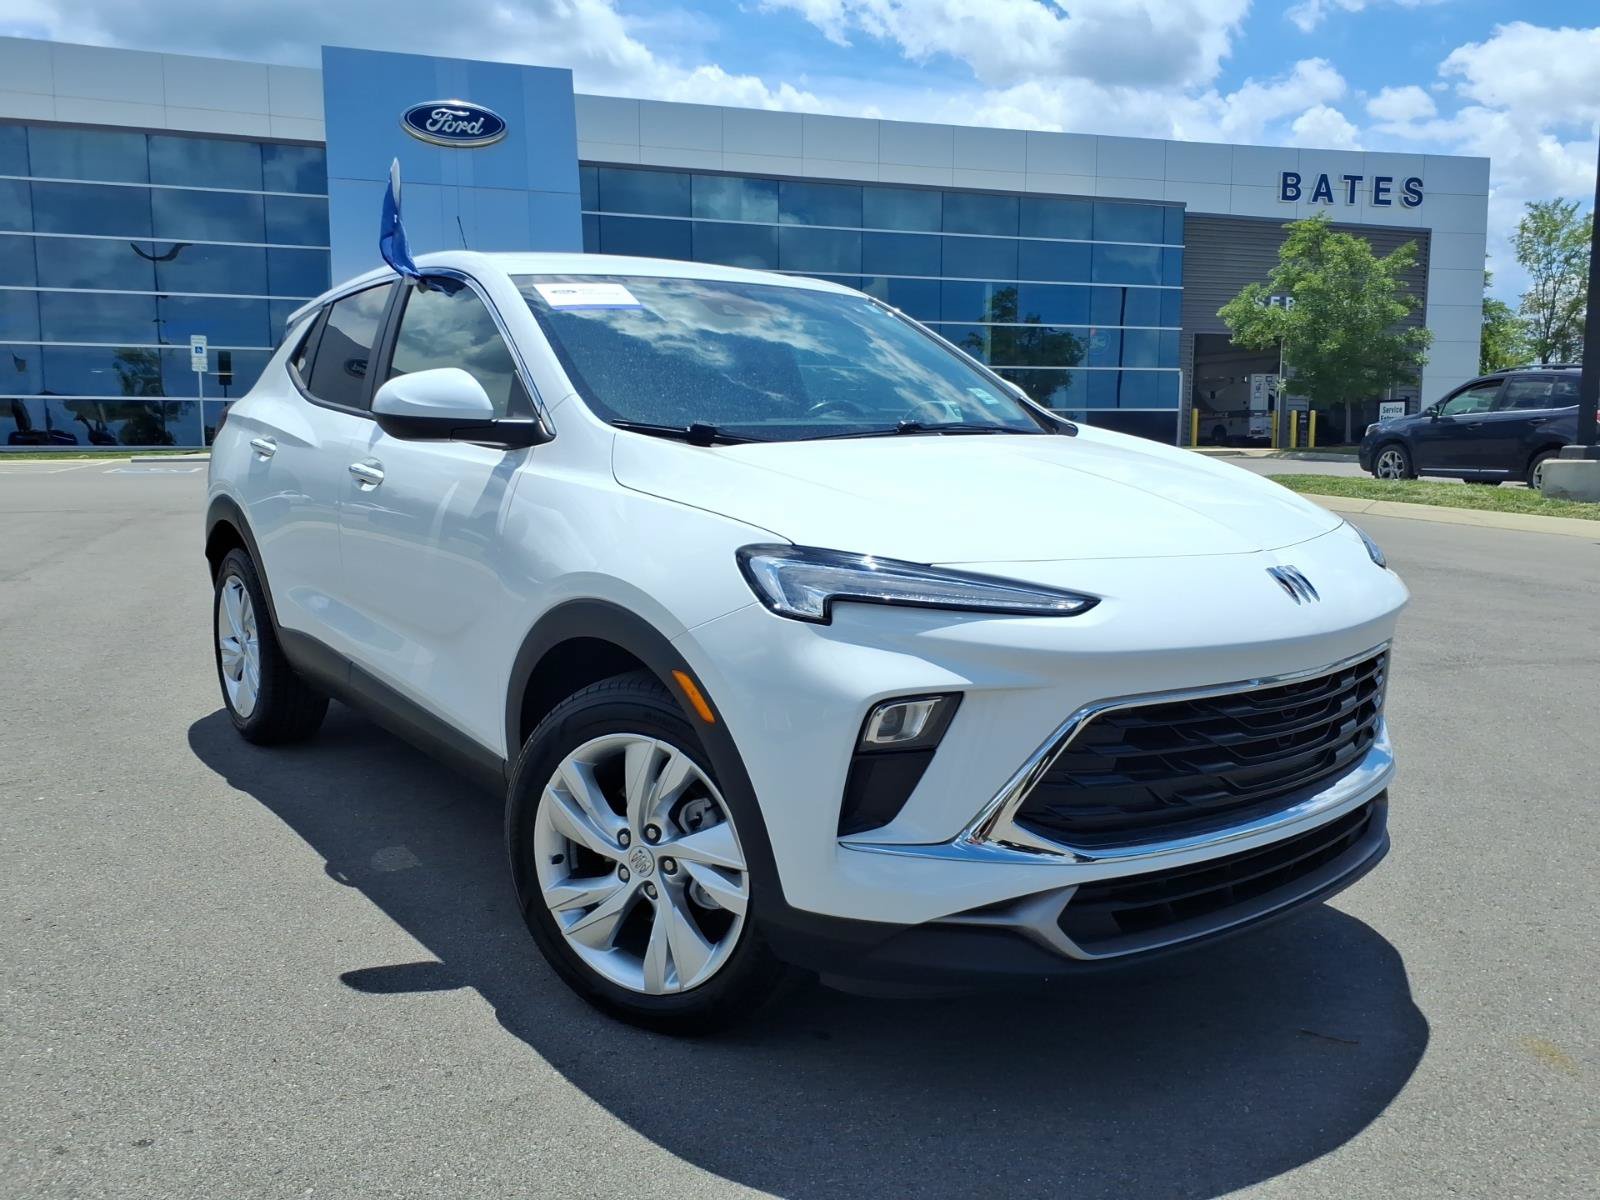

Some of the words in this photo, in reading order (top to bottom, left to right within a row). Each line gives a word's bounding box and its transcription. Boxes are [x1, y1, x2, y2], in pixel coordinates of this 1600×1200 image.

[425, 107, 485, 135] Ford
[1280, 171, 1424, 208] BATES
[1382, 406, 1403, 414] Service
